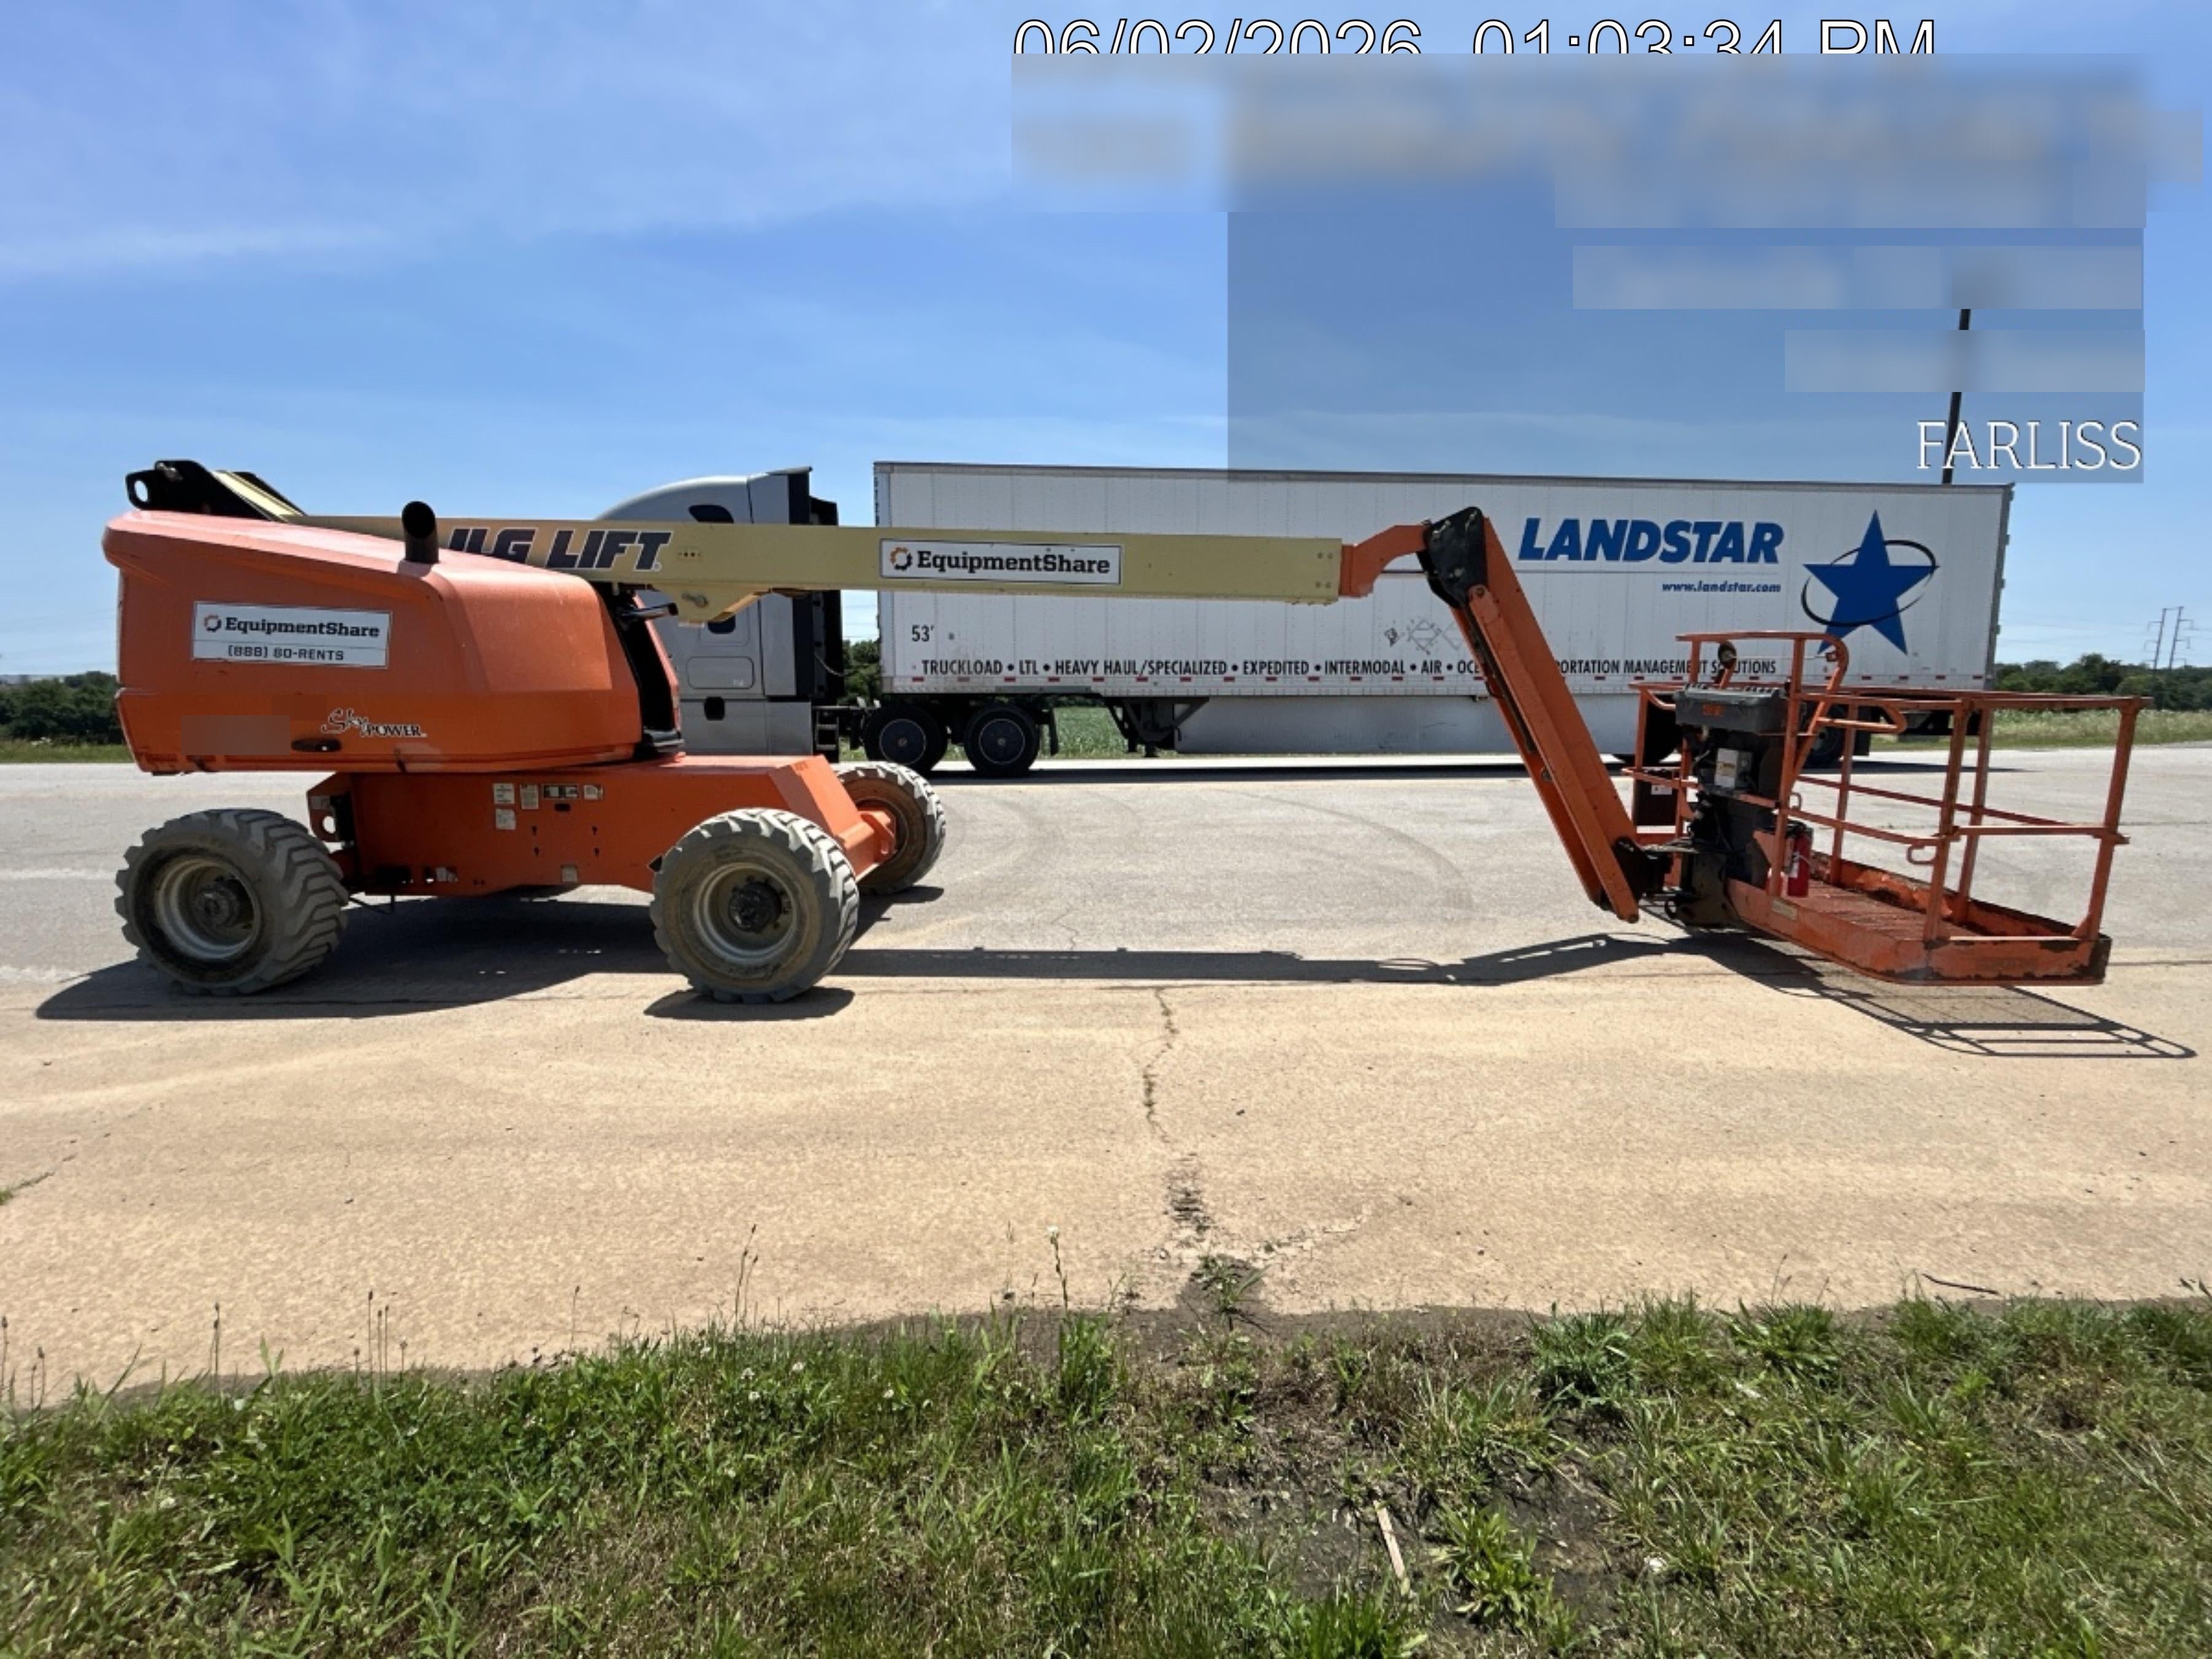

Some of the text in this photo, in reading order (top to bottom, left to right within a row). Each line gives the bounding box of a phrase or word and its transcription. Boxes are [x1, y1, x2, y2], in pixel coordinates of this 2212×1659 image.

[544, 529, 673, 571] LIFT
[1518, 517, 1784, 564] LANDSTAR
[917, 551, 1110, 574] EquipmentShare
[1662, 580, 1781, 593] www.landstar.com
[225, 616, 380, 637] EquipmentShare
[922, 659, 1776, 677] TRUCKLOAD LTL HEAVY HAUL/SPECIALIZED EXPEDITED INTERMODAL AIR OCE ORTATION MANAGEMET SUTIONS
